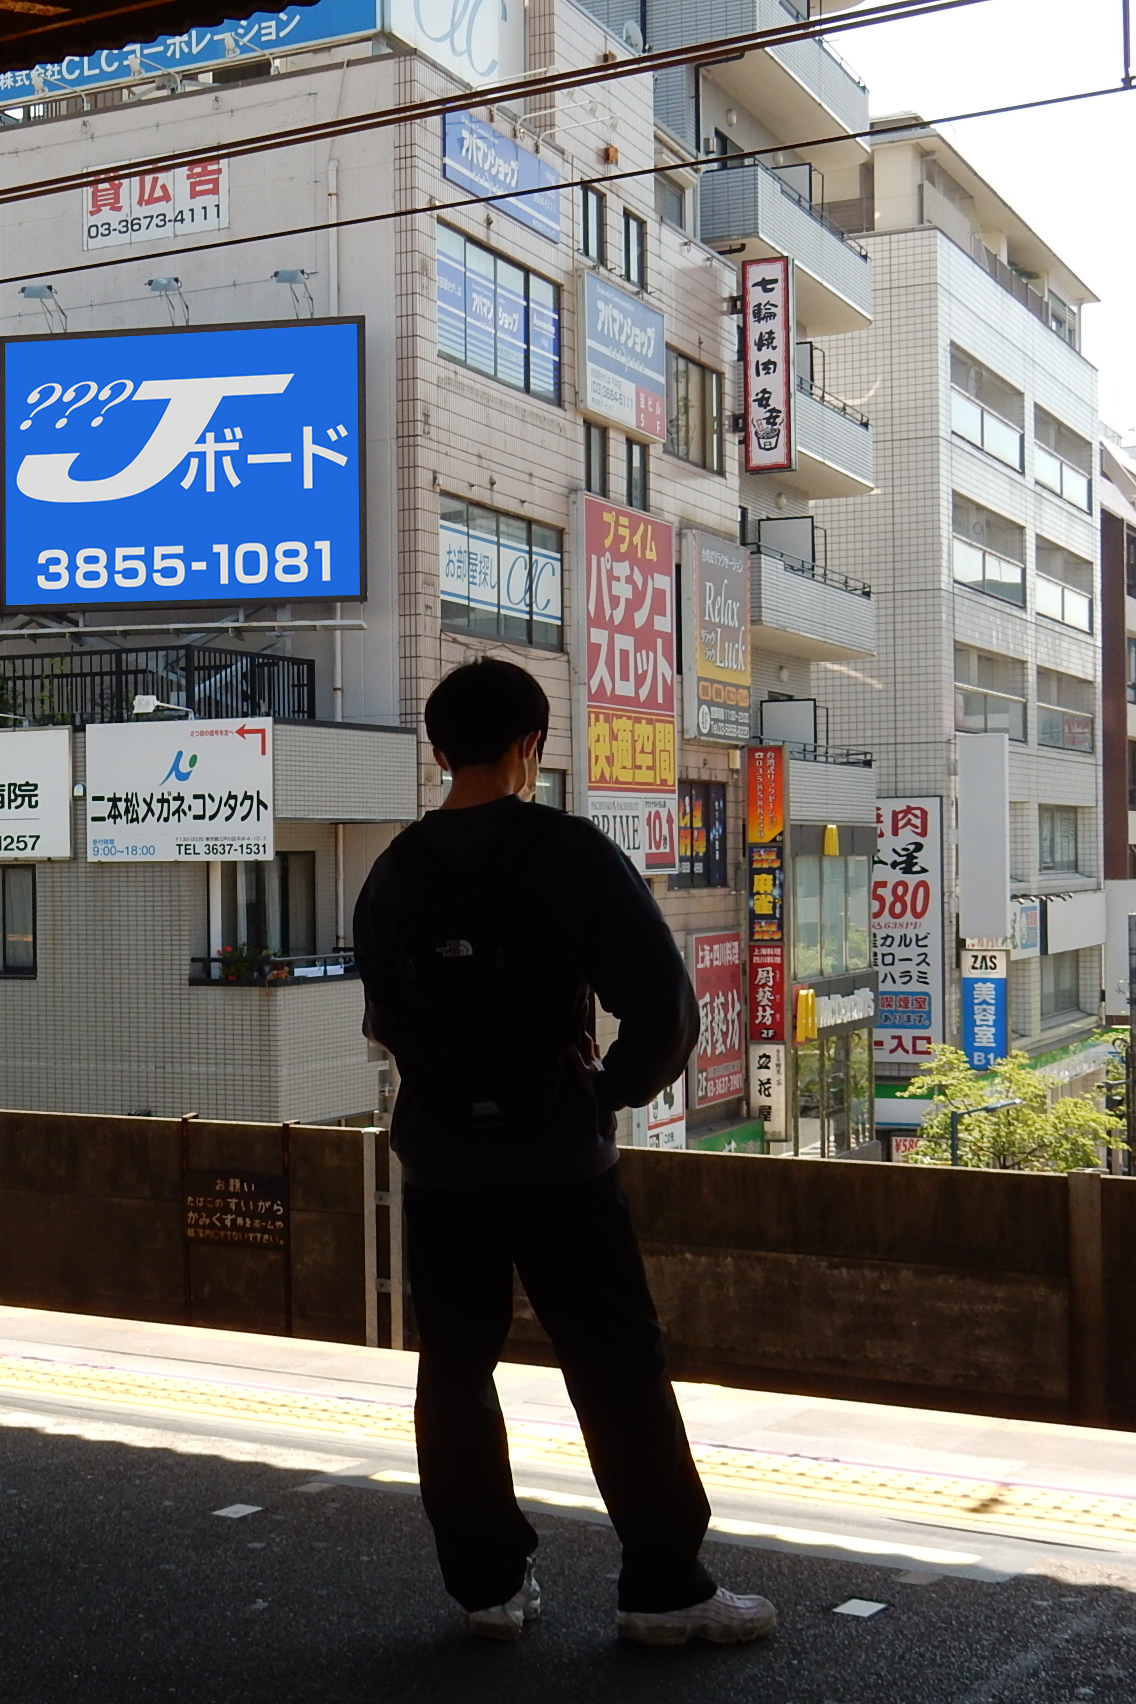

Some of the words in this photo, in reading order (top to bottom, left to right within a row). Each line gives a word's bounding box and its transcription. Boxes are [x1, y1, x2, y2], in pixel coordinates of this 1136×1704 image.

[88, 203, 221, 239] 03-3673-4111
[596, 299, 656, 359] アパマンショップ
[602, 511, 657, 562] プライム
[36, 540, 332, 591] 3855-1081
[588, 553, 672, 633] パチンコ
[704, 578, 740, 629] Relax
[589, 627, 672, 704] スロット
[715, 625, 746, 672] Luck
[589, 713, 674, 786] 快適空間
[90, 789, 269, 825] 二本松メガネ・コンタクト
[175, 843, 201, 855] TEL
[204, 843, 267, 855] 3637-1531
[872, 880, 931, 920] 580
[880, 970, 930, 985] ハラミ
[970, 954, 997, 970] ZAS
[880, 996, 927, 1010] 喫煙室
[973, 982, 996, 1047] 美容室
[760, 1029, 775, 1038] 2F
[973, 1052, 996, 1065] B1
[697, 1071, 706, 1097] 2F
[215, 1178, 255, 1192] お願い
